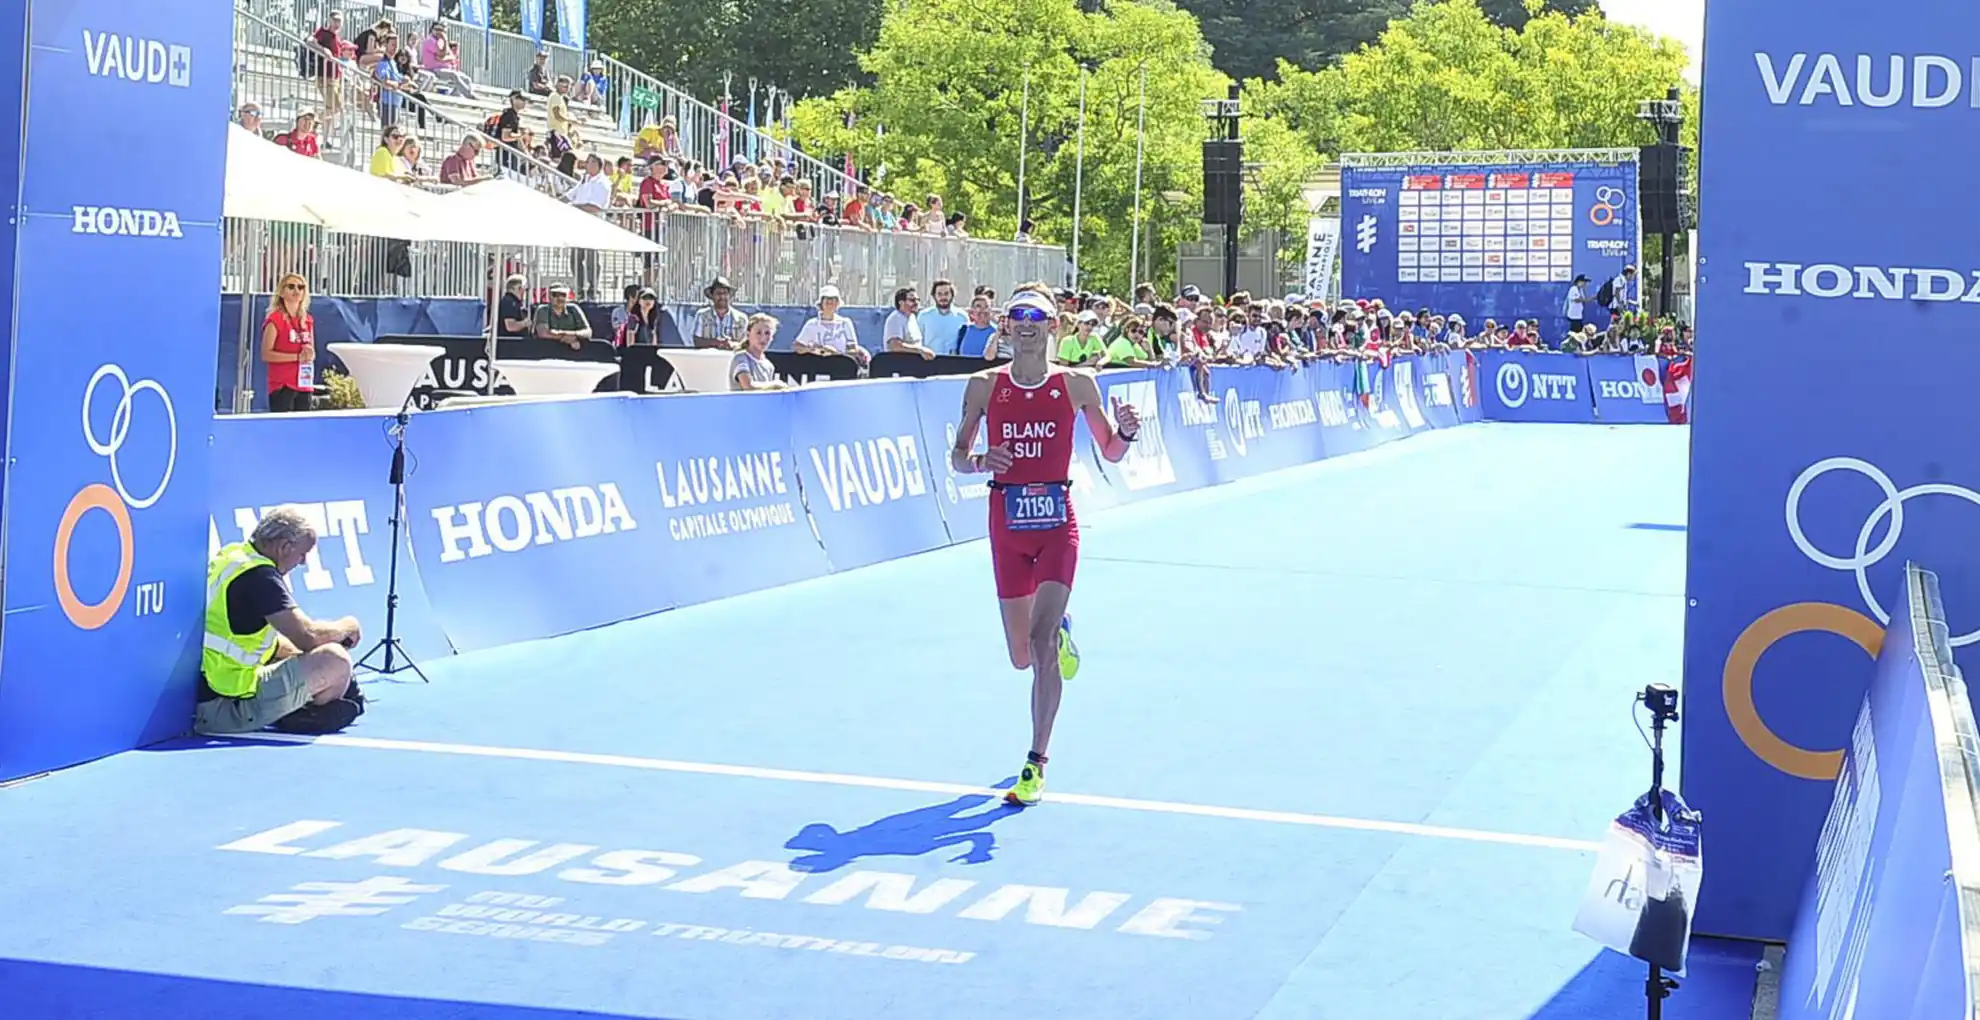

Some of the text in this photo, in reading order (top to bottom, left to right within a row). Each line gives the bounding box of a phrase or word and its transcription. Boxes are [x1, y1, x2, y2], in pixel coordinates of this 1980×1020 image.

[82, 29, 167, 83] VAUD
[1754, 52, 1962, 107] VAUD
[72, 205, 184, 238] HONDA
[1531, 373, 1577, 400] NTT
[1600, 380, 1646, 399] HON
[1002, 422, 1056, 439] BLANC
[1269, 398, 1318, 430] HONDA
[1014, 442, 1042, 458] SUI
[656, 451, 787, 508] LAUSANNE
[810, 436, 905, 512] VAUD
[431, 482, 638, 563] HONDA
[669, 502, 795, 541] CAPITALE OLYMPIQUE
[1015, 496, 1055, 518] 21150
[136, 581, 164, 616] ITU
[214, 819, 1245, 941] LAUSANNE
[435, 903, 978, 964] WORLD TRIATHLON
